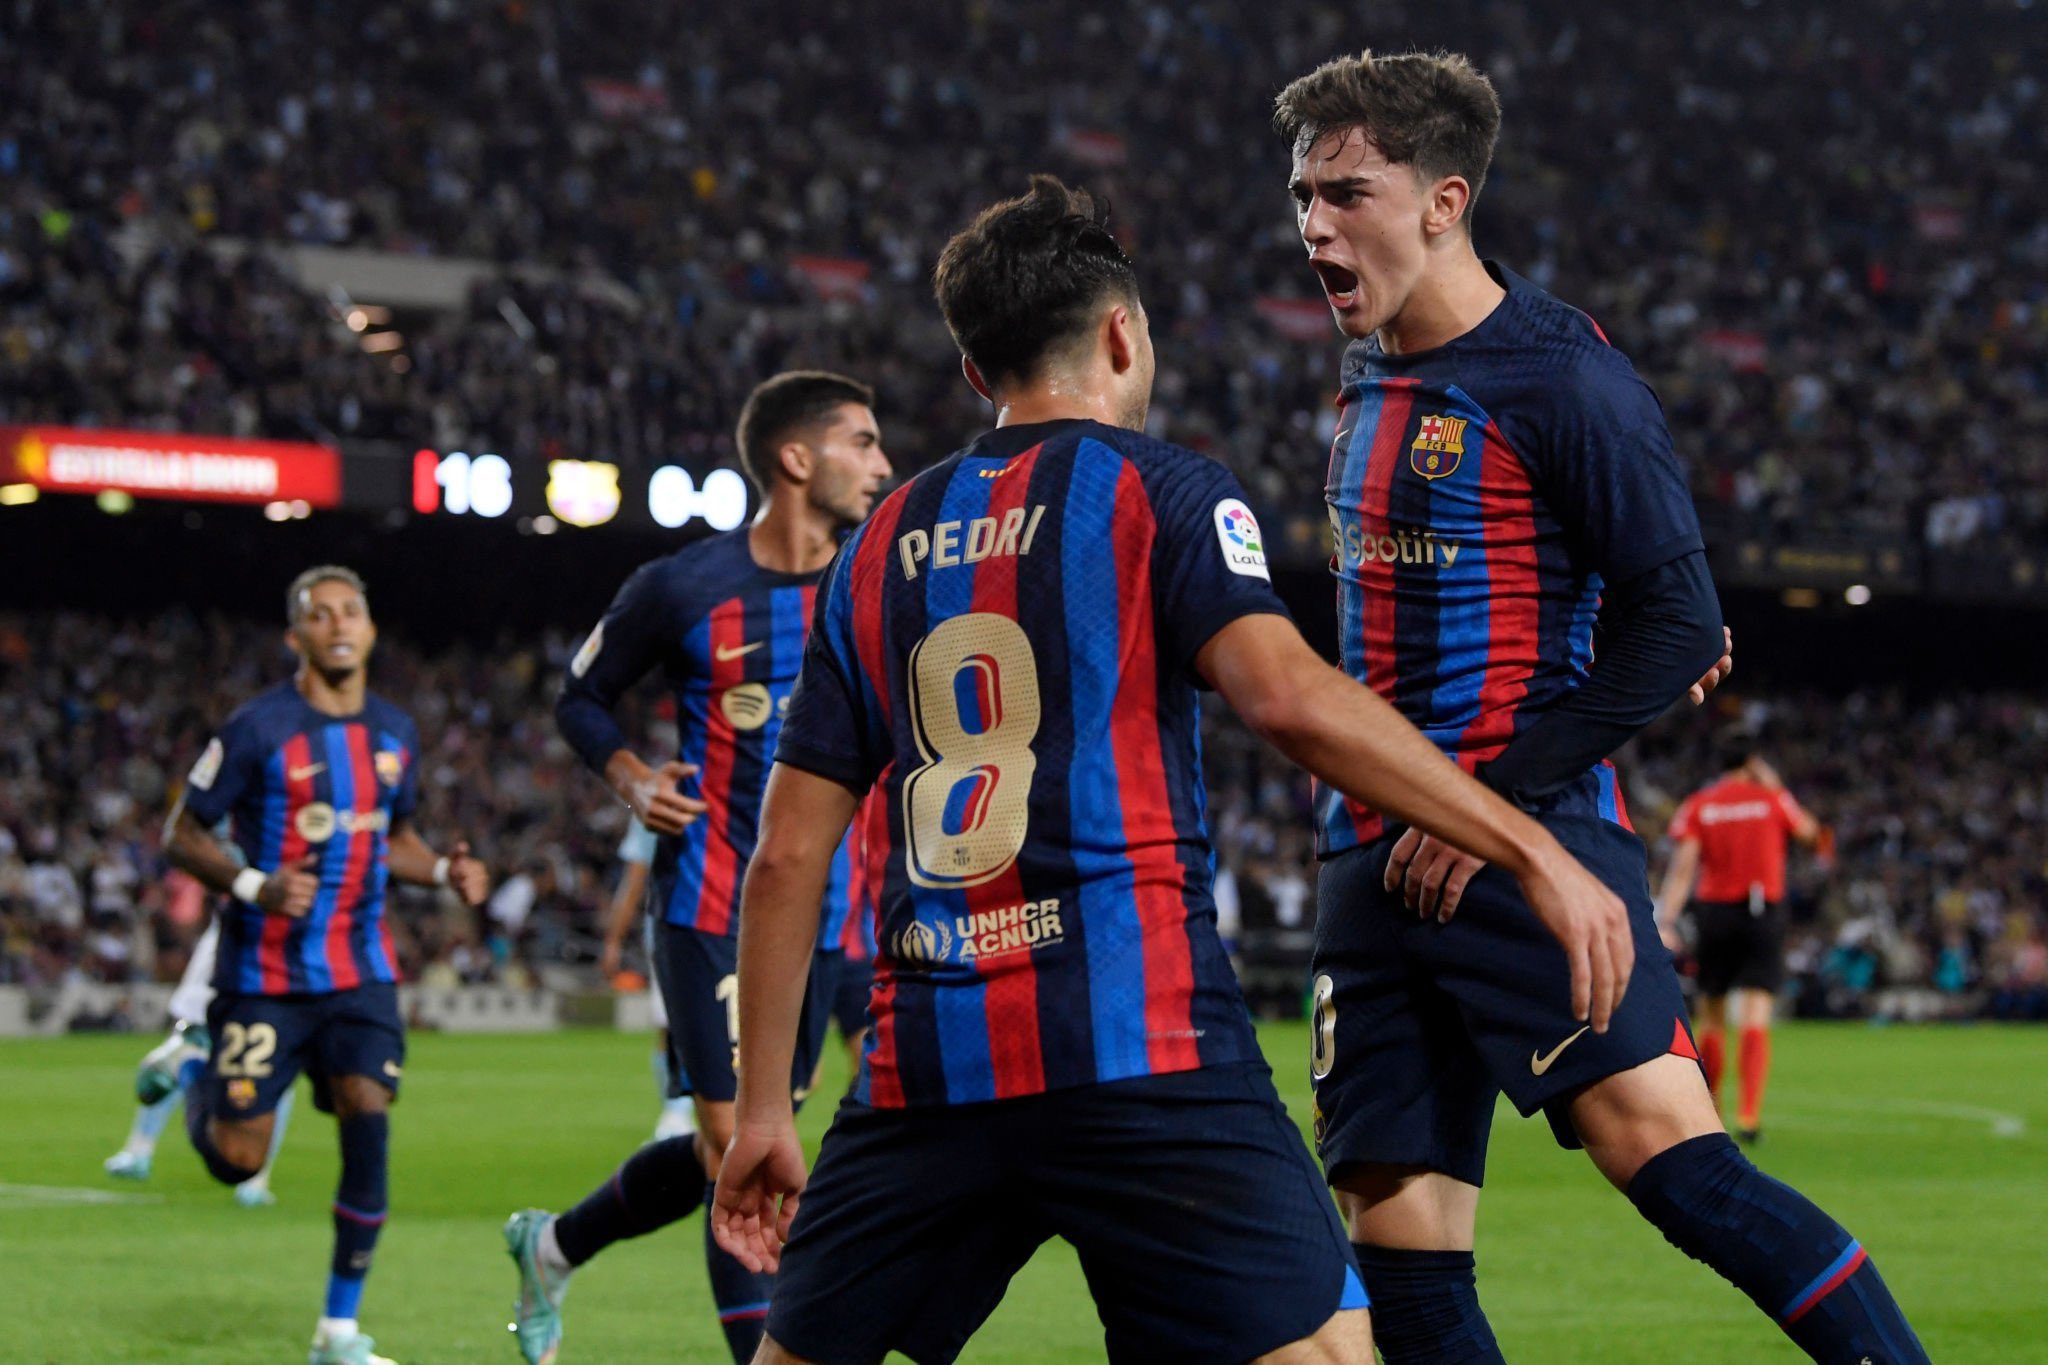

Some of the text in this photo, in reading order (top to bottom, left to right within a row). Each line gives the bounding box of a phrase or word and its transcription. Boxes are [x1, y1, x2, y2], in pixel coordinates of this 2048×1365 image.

[899, 505, 1046, 581] PEDRI
[902, 612, 1041, 888] 8
[955, 898, 1060, 939] UNHCR
[958, 914, 1064, 957] ACNUR
[219, 1022, 277, 1077] 22
